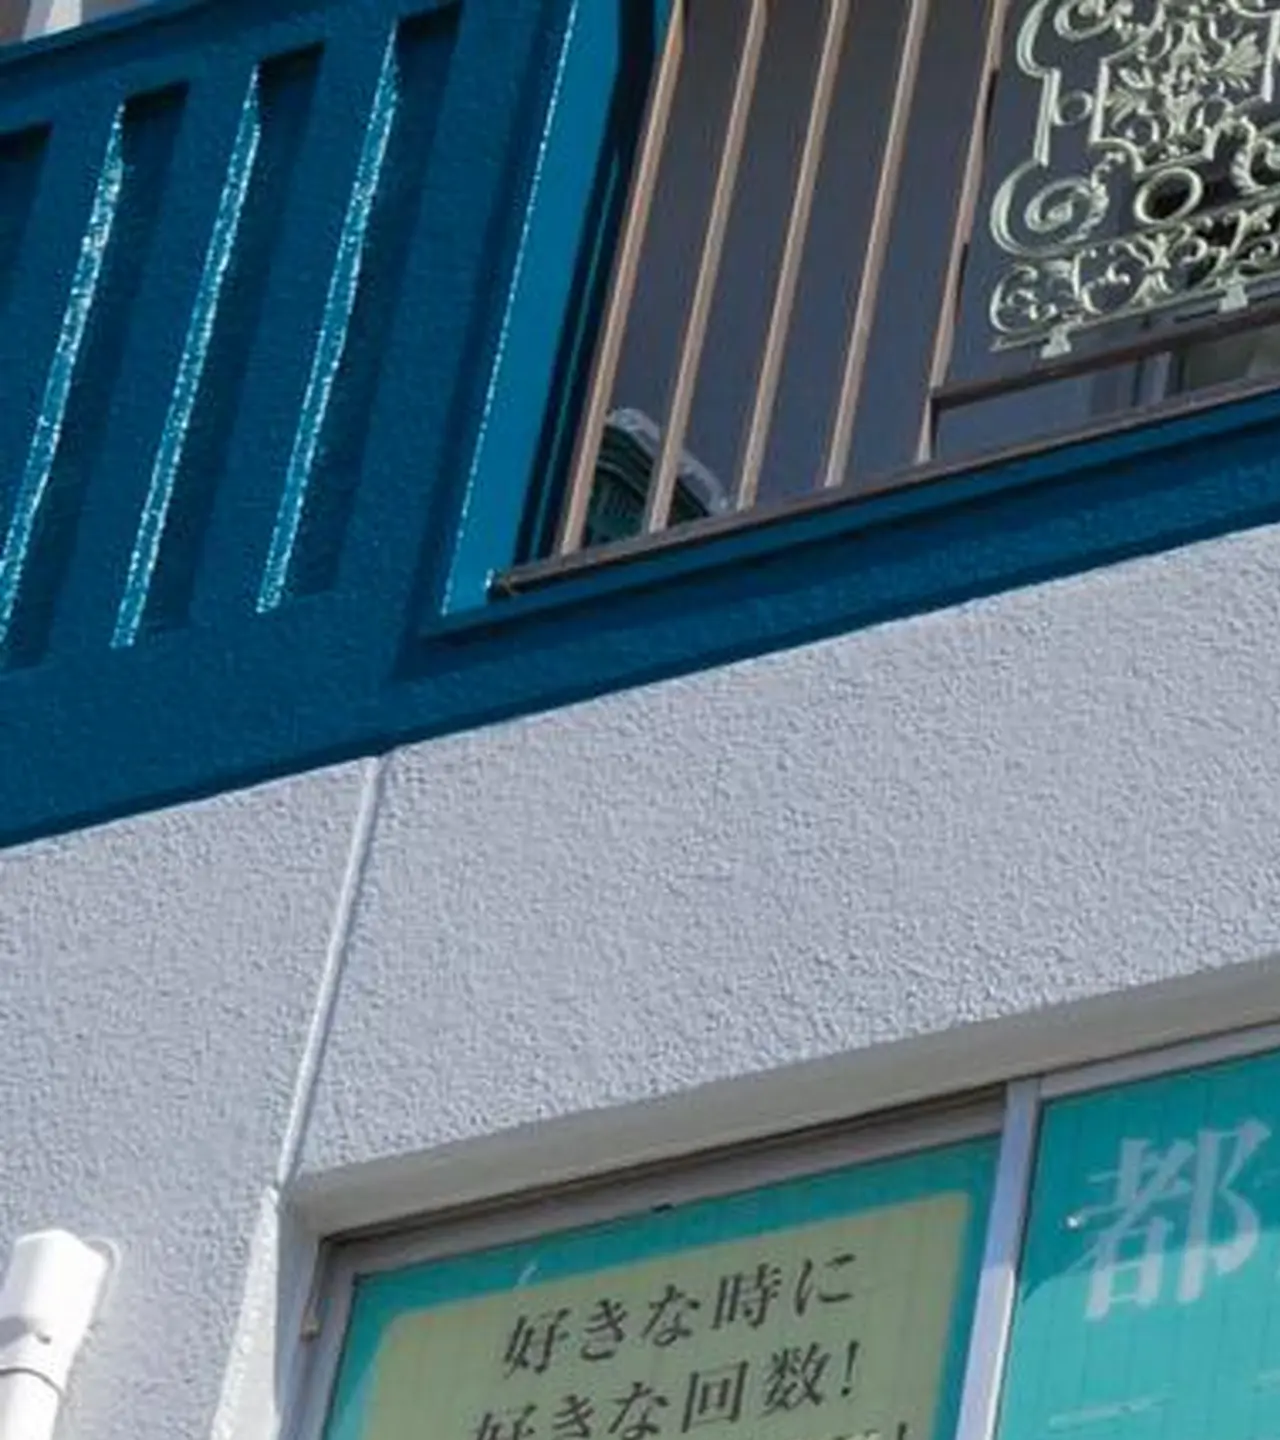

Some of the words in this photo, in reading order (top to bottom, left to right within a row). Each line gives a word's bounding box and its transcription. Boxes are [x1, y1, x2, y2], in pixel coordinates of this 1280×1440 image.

[502, 1252, 858, 1380] 好きな時に
